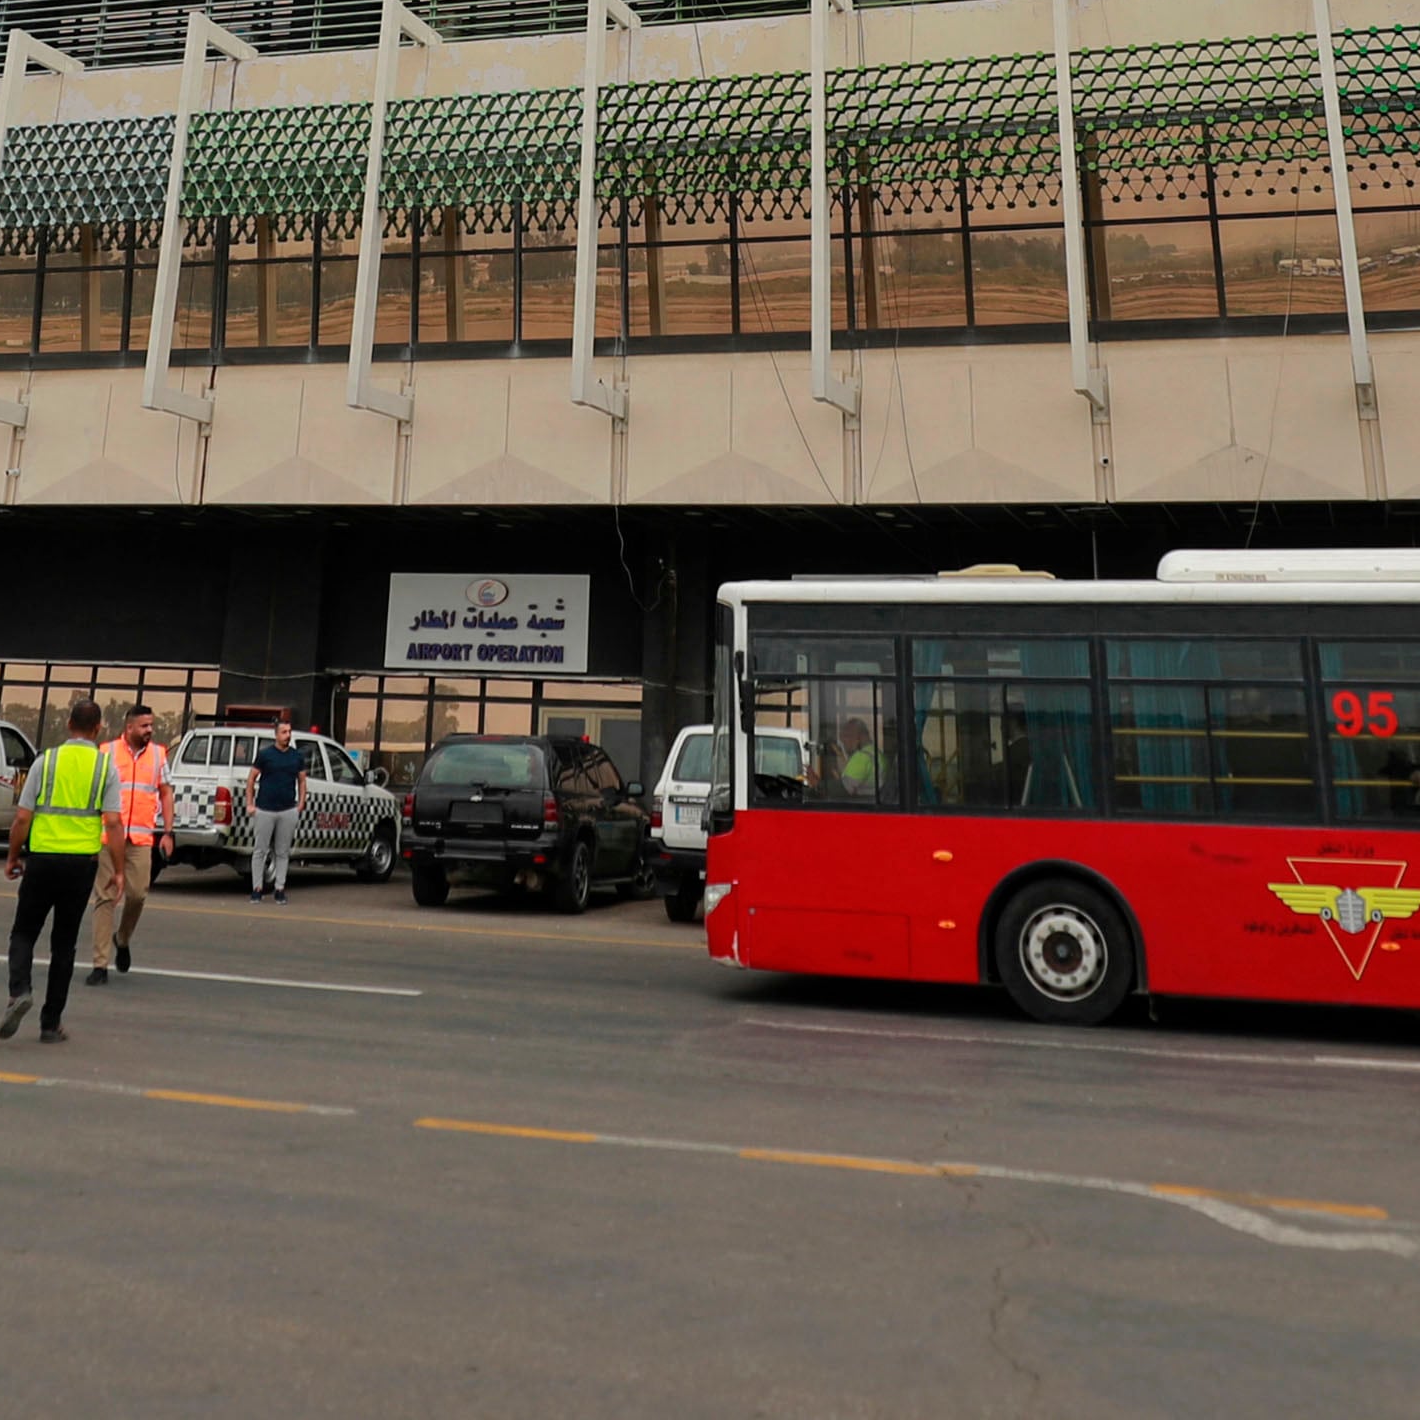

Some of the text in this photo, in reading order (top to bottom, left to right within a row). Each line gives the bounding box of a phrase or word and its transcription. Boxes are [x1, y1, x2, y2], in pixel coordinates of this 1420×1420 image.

[409, 598, 565, 638] شعبة عمليات المطار
[406, 642, 564, 664] AIRPORT OPERATION
[1332, 690, 1399, 738] 95
